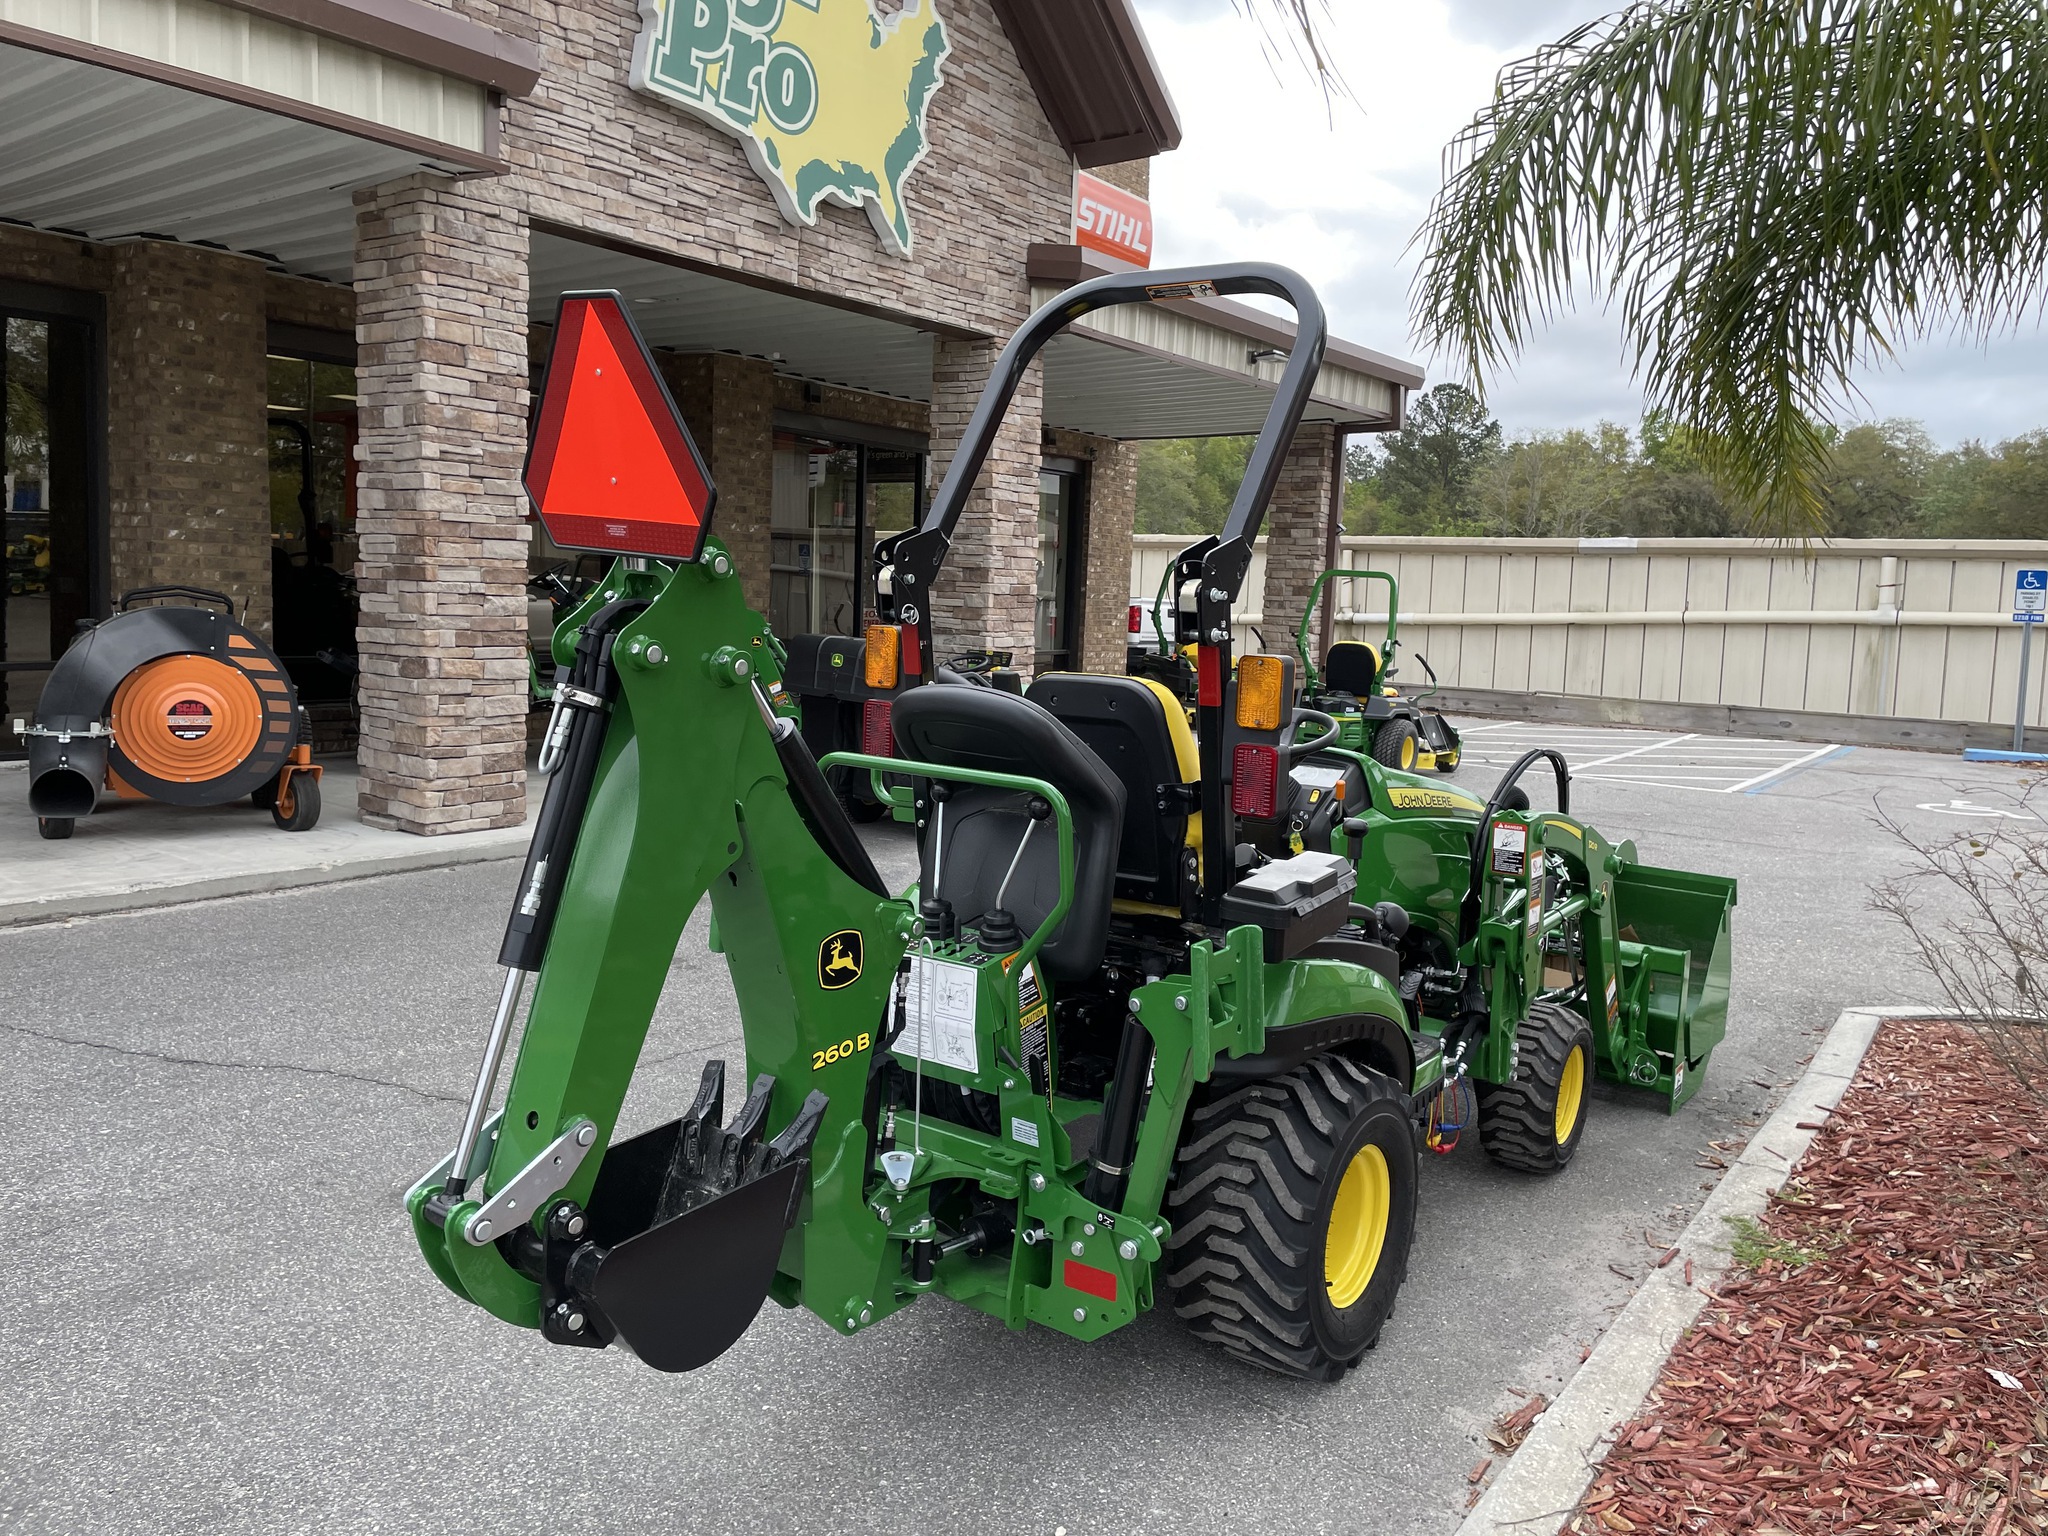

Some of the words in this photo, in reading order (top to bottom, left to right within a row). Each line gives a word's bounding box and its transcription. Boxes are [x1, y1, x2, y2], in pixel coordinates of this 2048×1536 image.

[655, 0, 818, 133] Pro
[1076, 197, 1147, 253] STIHL
[176, 703, 204, 713] SCAG
[1399, 793, 1424, 806] JOHN
[1424, 793, 1453, 806] DEERE
[1022, 1007, 1044, 1027] CAUTION
[812, 1039, 854, 1071] 260
[857, 1032, 871, 1052] B
